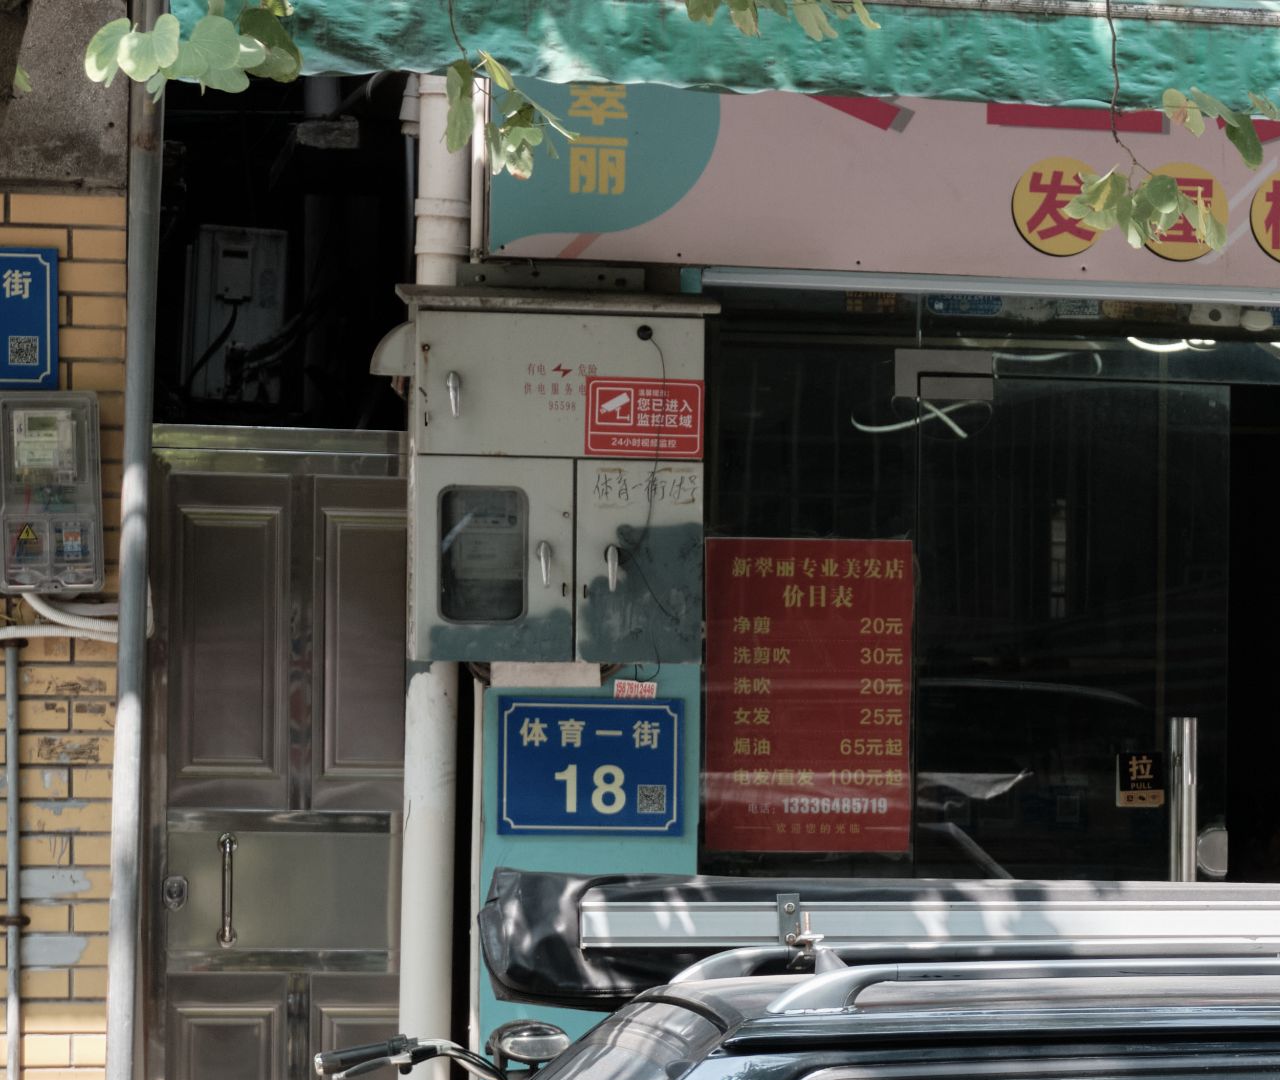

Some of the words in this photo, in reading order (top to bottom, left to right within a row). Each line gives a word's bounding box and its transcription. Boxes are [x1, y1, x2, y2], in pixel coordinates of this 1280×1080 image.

[2, 269, 32, 299] 街
[527, 363, 547, 377] 有电
[577, 363, 599, 377] 危险
[549, 400, 576, 412] 95598
[637, 398, 693, 413] 您已进入
[637, 413, 693, 428] 监控区域
[732, 556, 906, 580] 新翠丽专业美发店
[783, 585, 854, 609] 价目表
[733, 616, 772, 635] 净剪
[859, 617, 904, 635] 20元
[733, 646, 791, 665] 洗剪吹
[859, 647, 904, 665] 30元
[733, 677, 771, 695] 洗吹
[859, 678, 904, 696] 20元
[734, 707, 771, 725] 女发
[859, 708, 904, 726] 25元
[519, 717, 661, 750] 体育一街
[839, 738, 904, 756] 65元起
[829, 768, 904, 786] 100元起
[1129, 755, 1154, 780] 拉
[554, 764, 627, 815] 18
